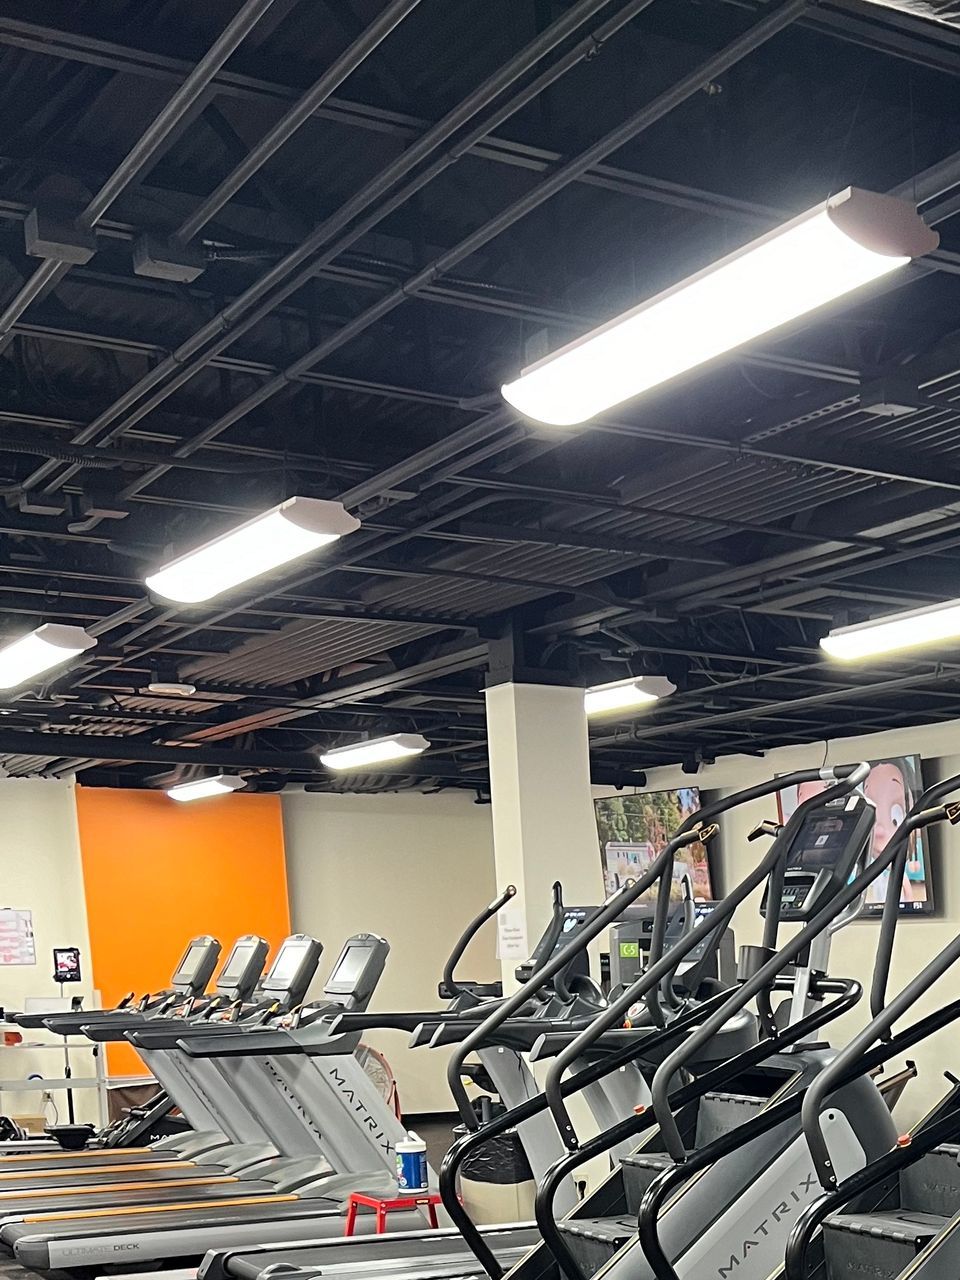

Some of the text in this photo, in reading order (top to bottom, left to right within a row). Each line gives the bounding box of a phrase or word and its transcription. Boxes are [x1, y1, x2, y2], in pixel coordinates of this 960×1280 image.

[623, 944, 636, 955] C-5
[329, 1067, 395, 1156] MATRIX
[113, 1243, 140, 1252] DECK
[718, 1172, 817, 1280] MATRIX
